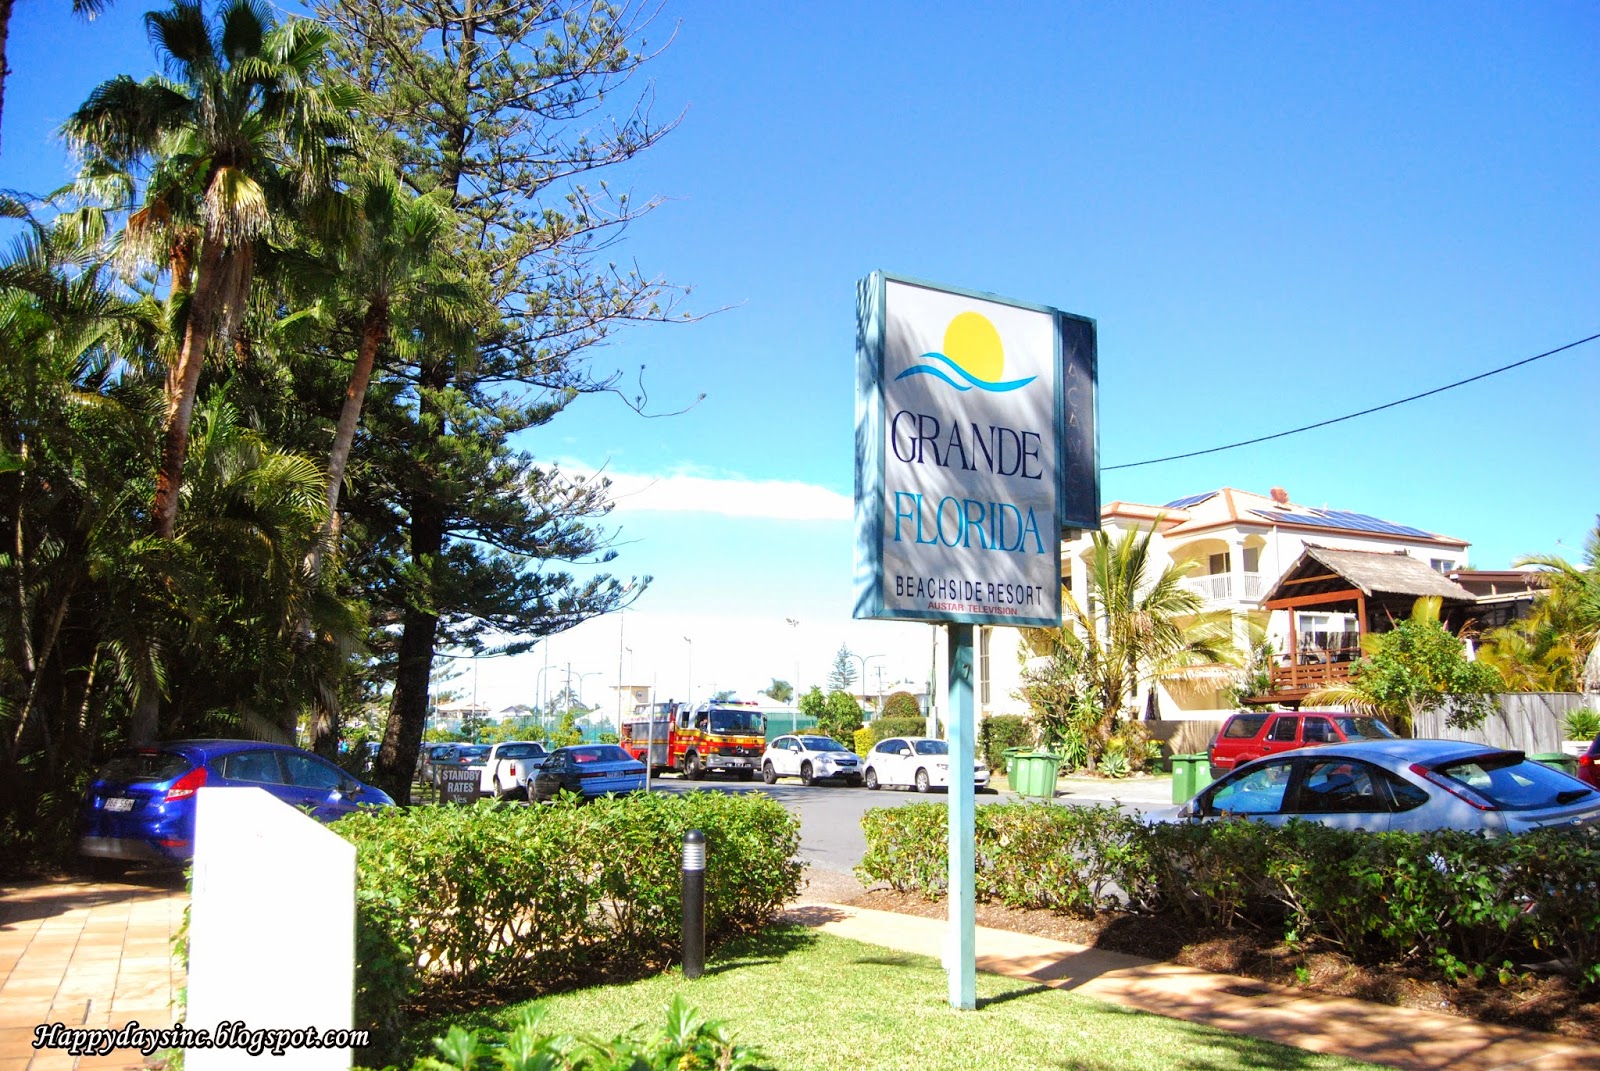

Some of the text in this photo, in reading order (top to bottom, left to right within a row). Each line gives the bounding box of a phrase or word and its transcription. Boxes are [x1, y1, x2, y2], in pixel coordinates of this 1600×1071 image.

[891, 410, 1043, 480] GRANDE
[894, 491, 1045, 555] FLORIDA
[896, 575, 1043, 606] BEACHSIDE RESORT
[927, 601, 1018, 615] AUSTAR TELEVISION
[442, 770, 480, 781] STANDBY
[447, 782, 474, 793] RATES
[453, 794, 468, 804] Yes
